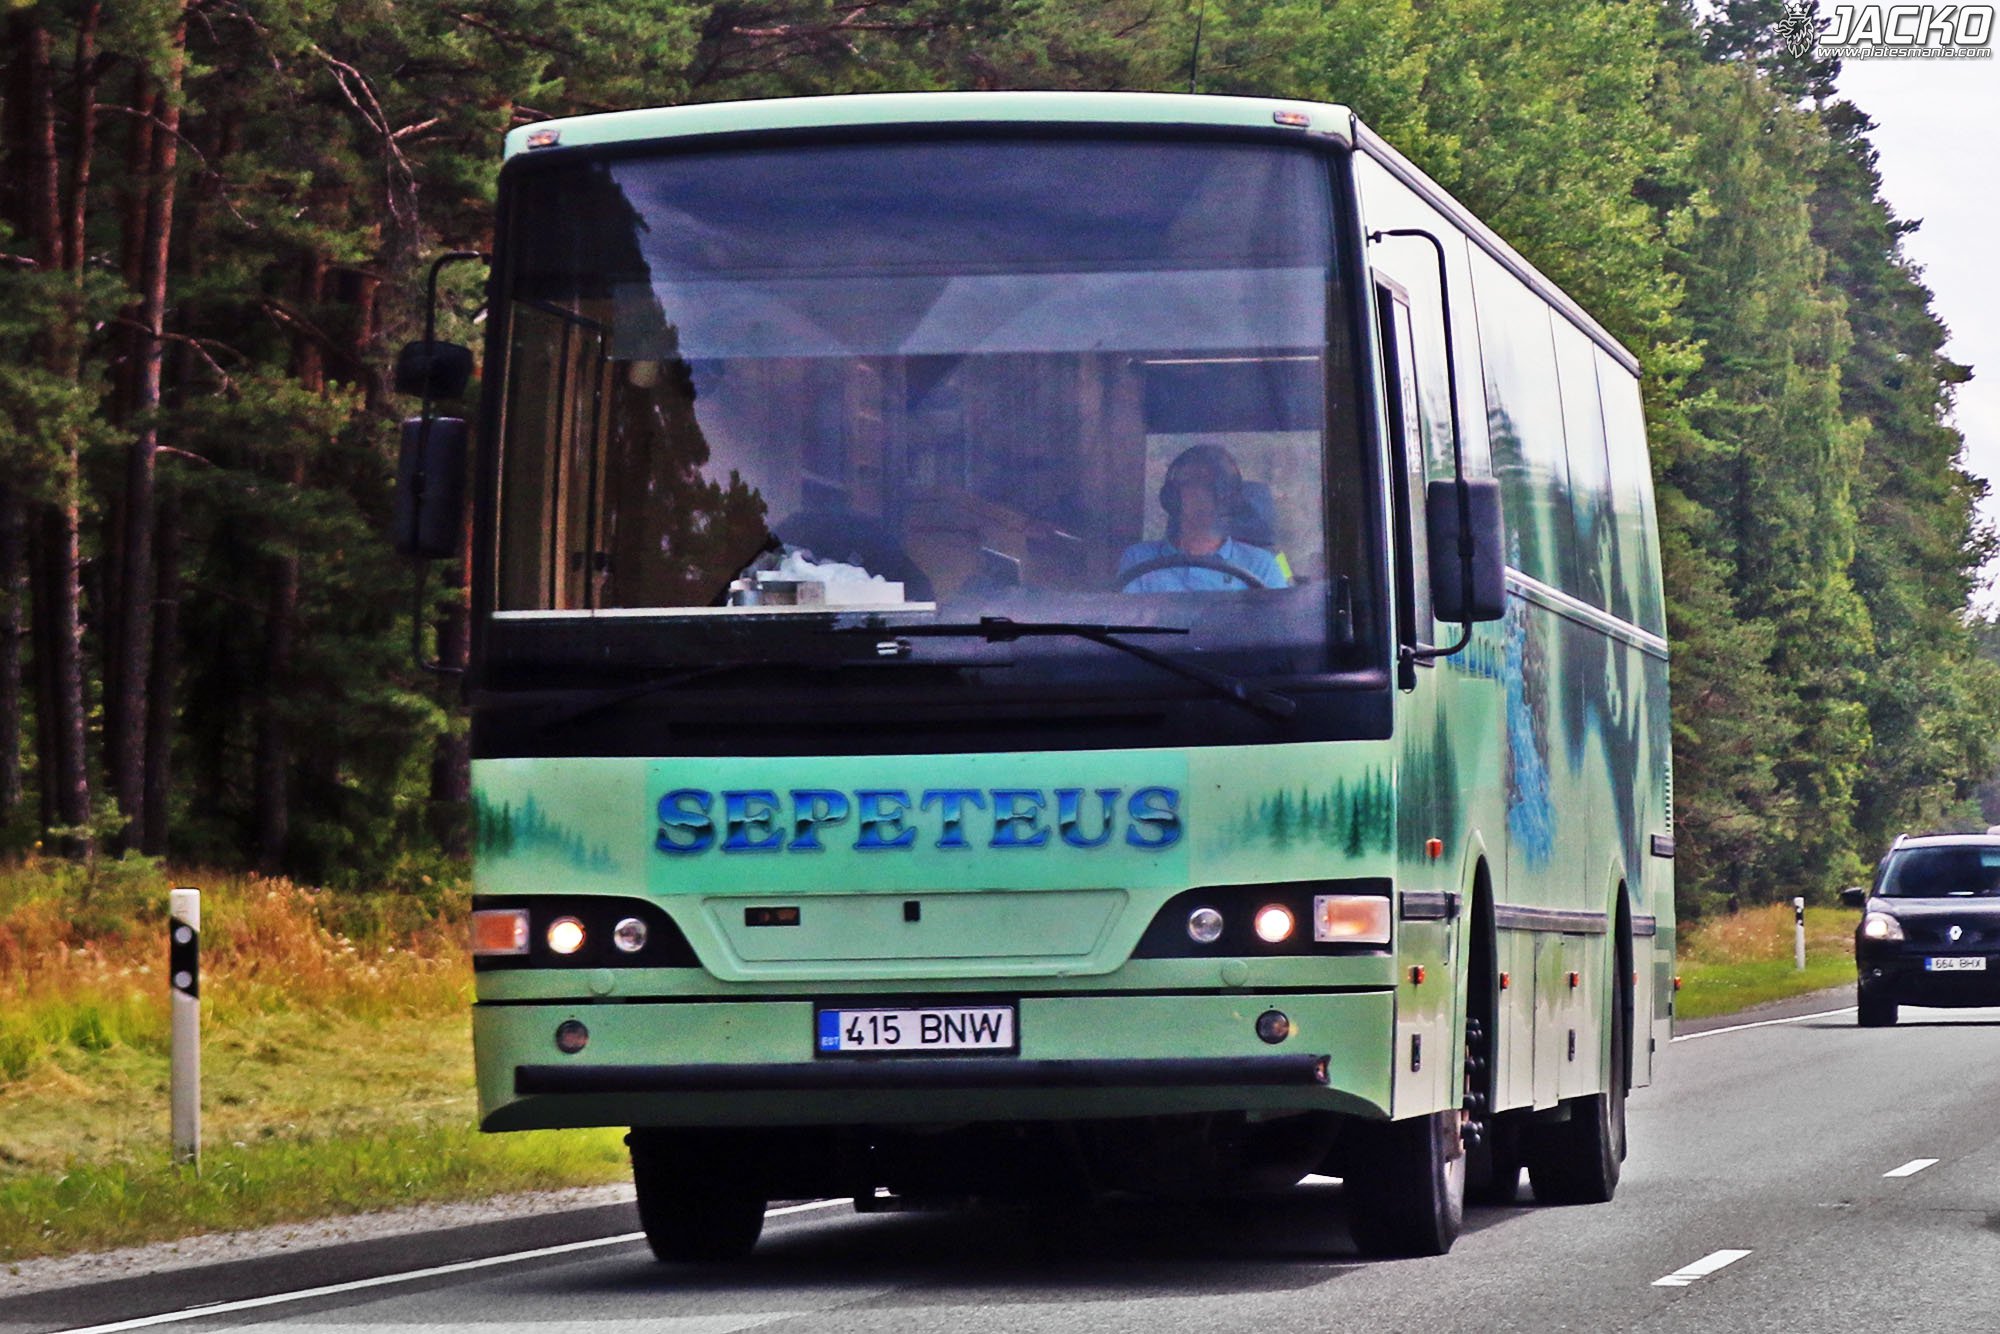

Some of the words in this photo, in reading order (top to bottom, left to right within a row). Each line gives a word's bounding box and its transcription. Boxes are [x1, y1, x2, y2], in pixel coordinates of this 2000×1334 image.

[655, 786, 1184, 854] SEPETEUS
[821, 1036, 841, 1046] EST
[846, 1014, 901, 1045] 415
[920, 1012, 1003, 1044] BNW
